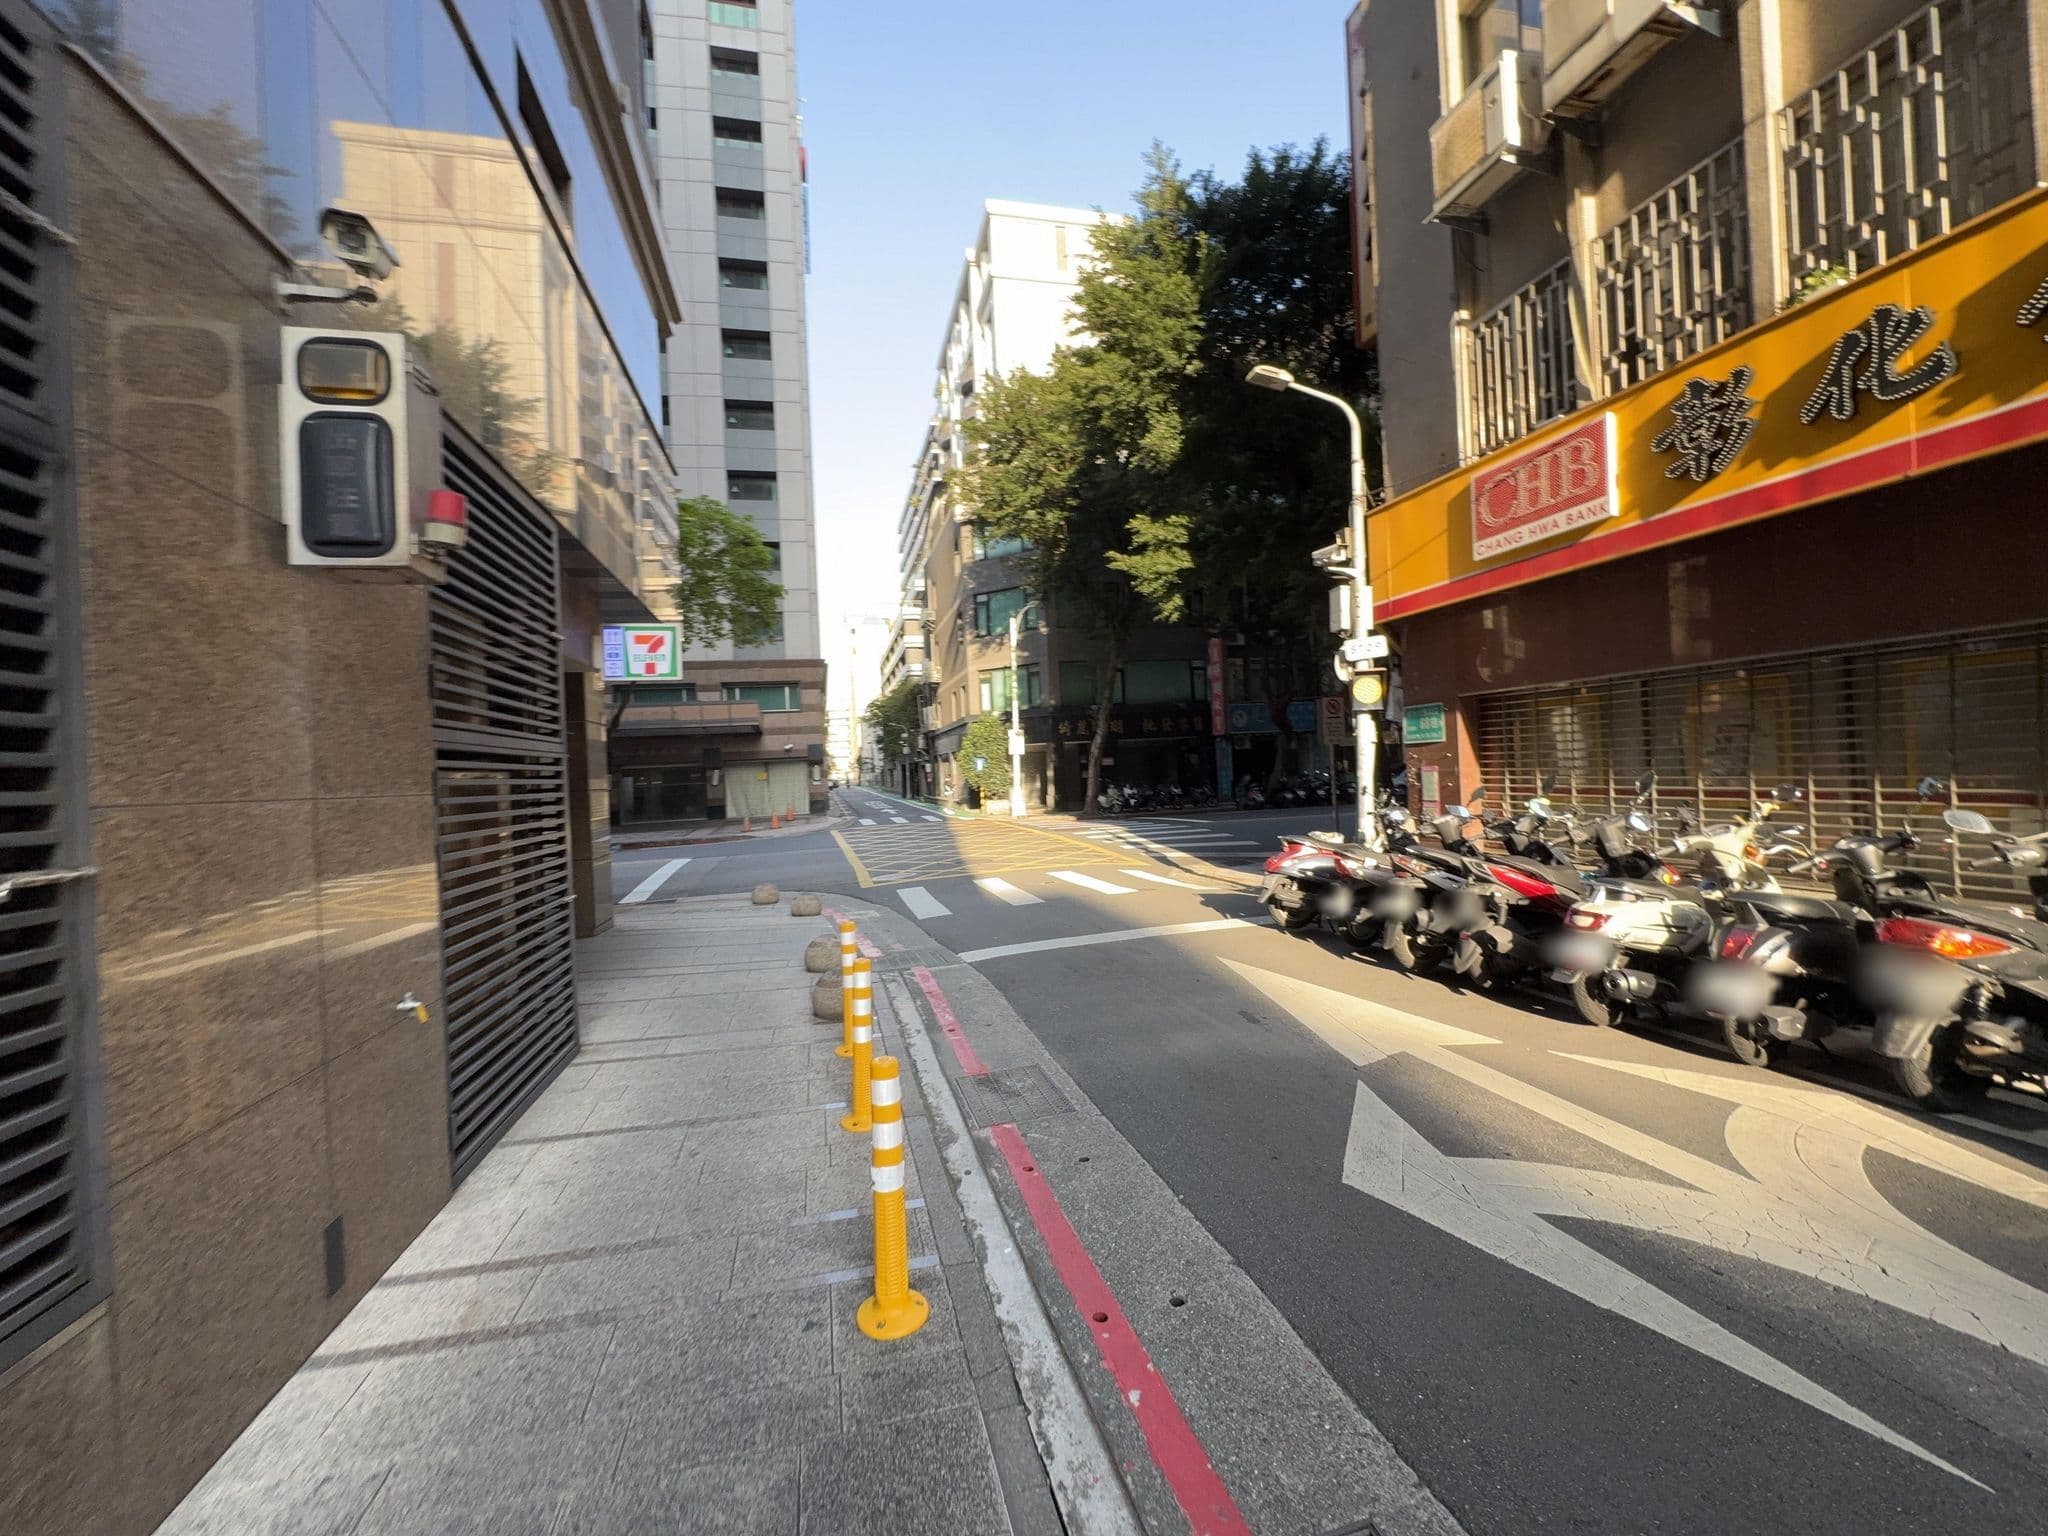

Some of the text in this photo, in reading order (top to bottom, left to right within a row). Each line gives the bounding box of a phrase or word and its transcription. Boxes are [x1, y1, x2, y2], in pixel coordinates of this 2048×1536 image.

[1650, 277, 2048, 482] 彰化
[1478, 437, 1599, 528] CHB
[1477, 502, 1608, 556] CHANG HWA BANK
[633, 634, 665, 674] 7
